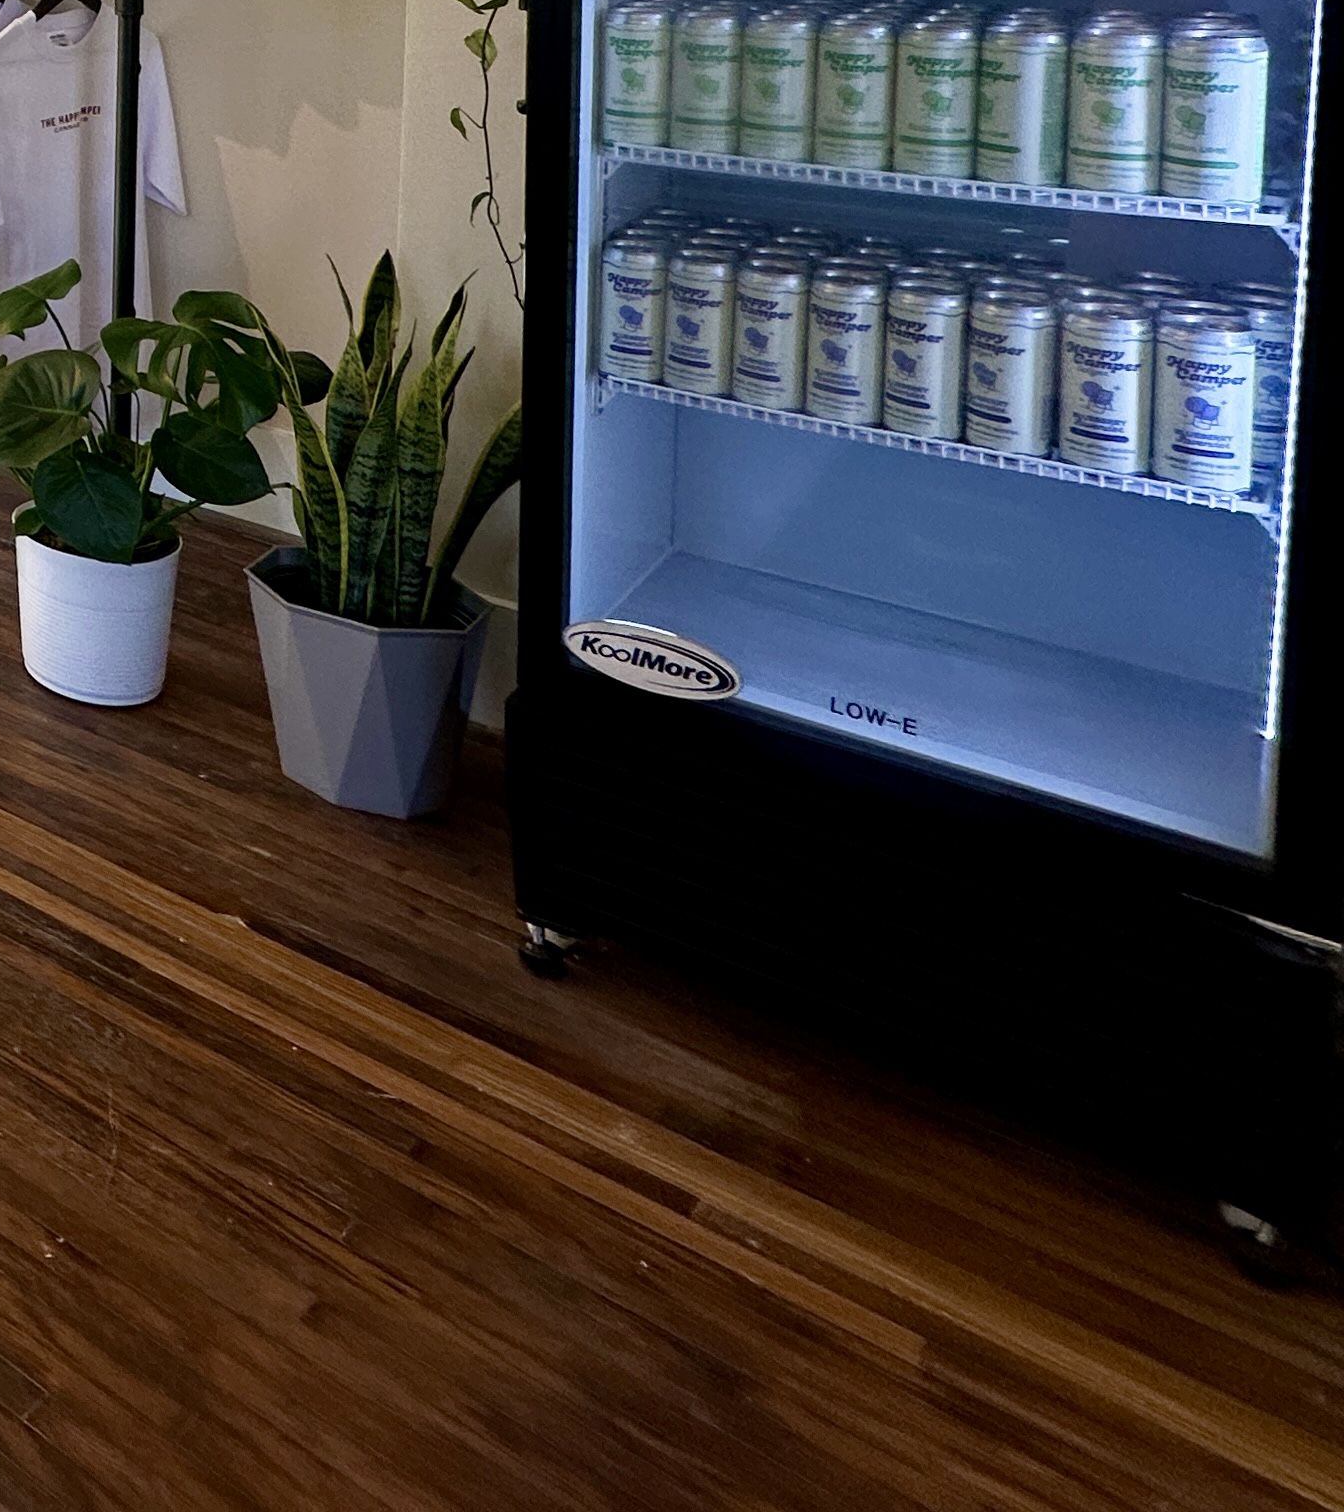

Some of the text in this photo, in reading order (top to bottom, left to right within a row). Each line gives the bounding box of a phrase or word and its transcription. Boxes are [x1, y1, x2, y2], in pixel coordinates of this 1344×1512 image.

[41, 117, 56, 128] THE
[1065, 340, 1125, 361] Happy
[1073, 353, 1142, 374] Camper
[1165, 355, 1232, 375] Happy
[1175, 367, 1247, 388] Camper
[580, 635, 714, 686] KoolMore
[830, 696, 918, 737] LOW-E
